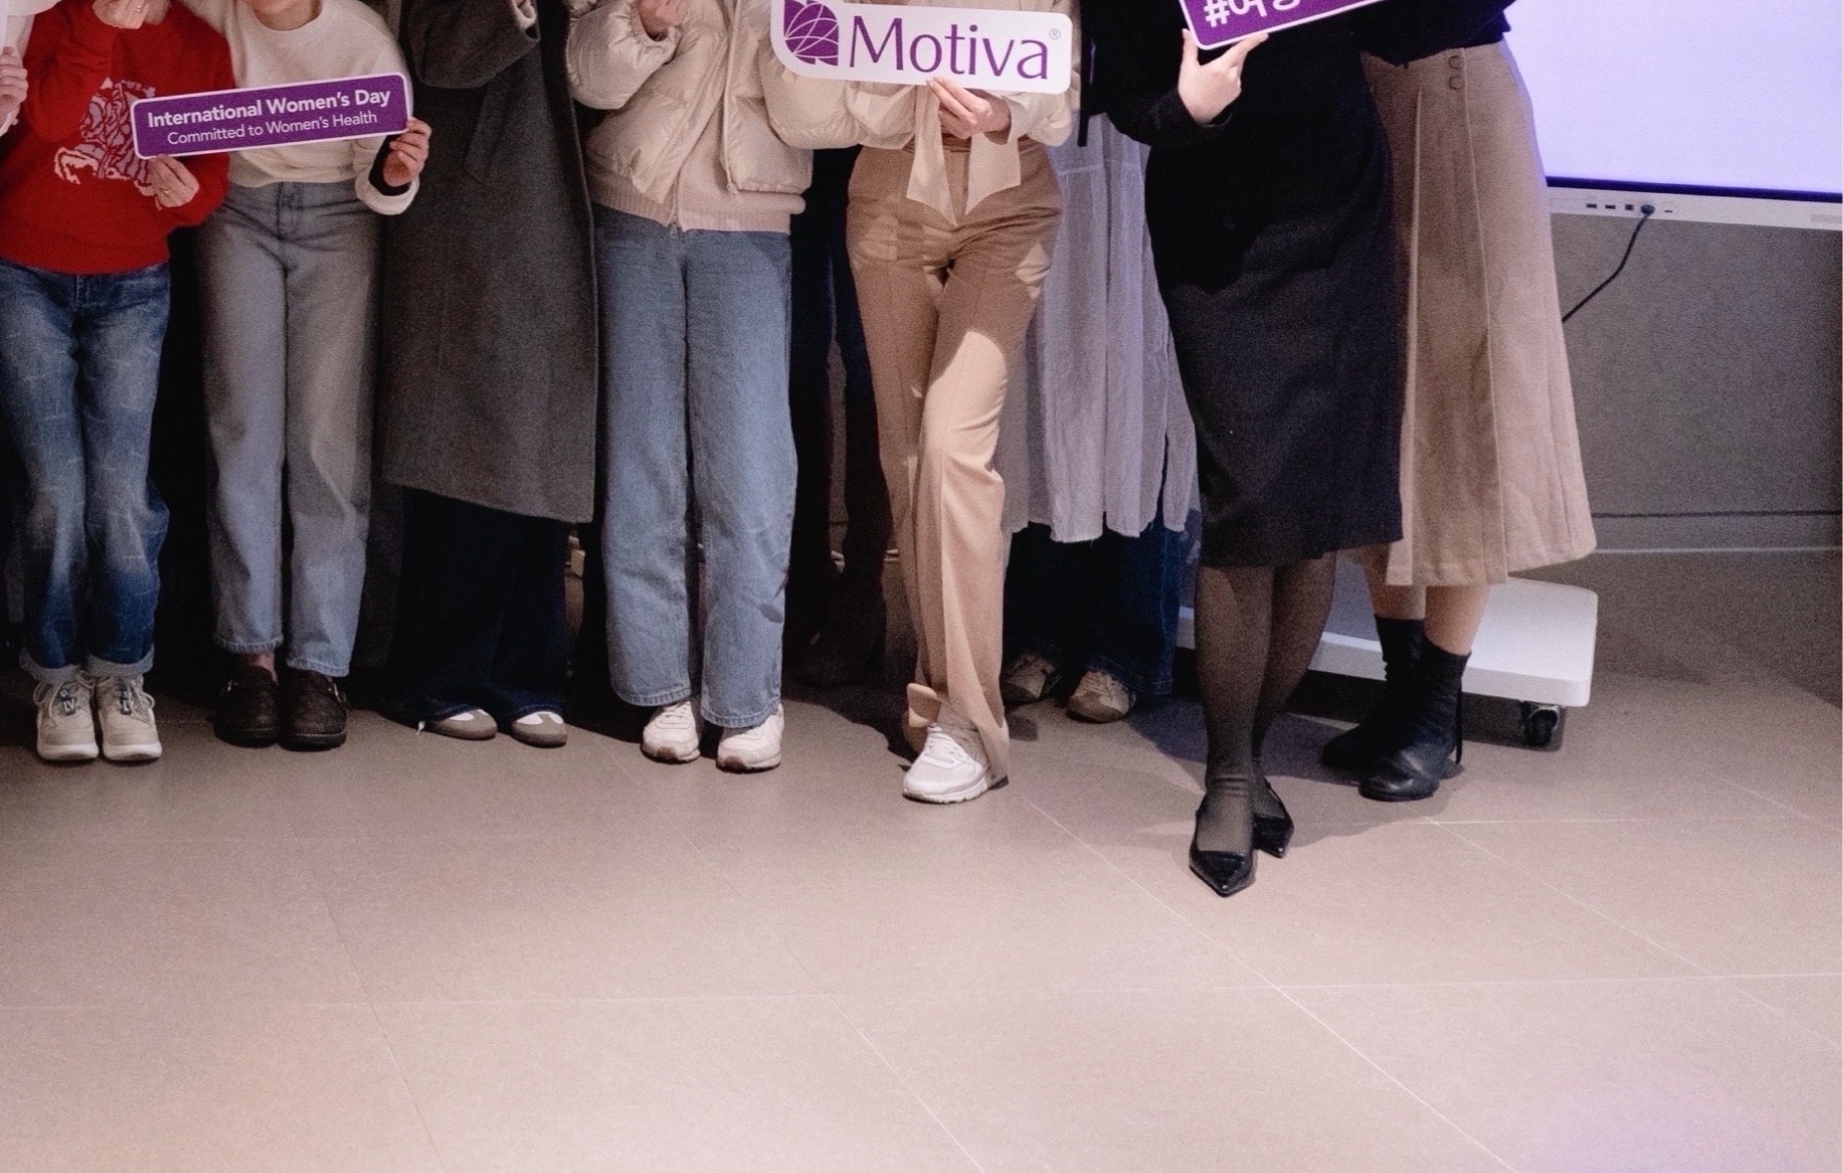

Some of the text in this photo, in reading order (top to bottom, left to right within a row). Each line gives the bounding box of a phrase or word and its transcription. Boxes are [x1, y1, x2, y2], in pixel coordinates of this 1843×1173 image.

[147, 100, 263, 128] International
[355, 88, 391, 108] Day
[167, 124, 246, 146] Committed
[249, 124, 264, 137] to
[333, 110, 378, 126] Health
